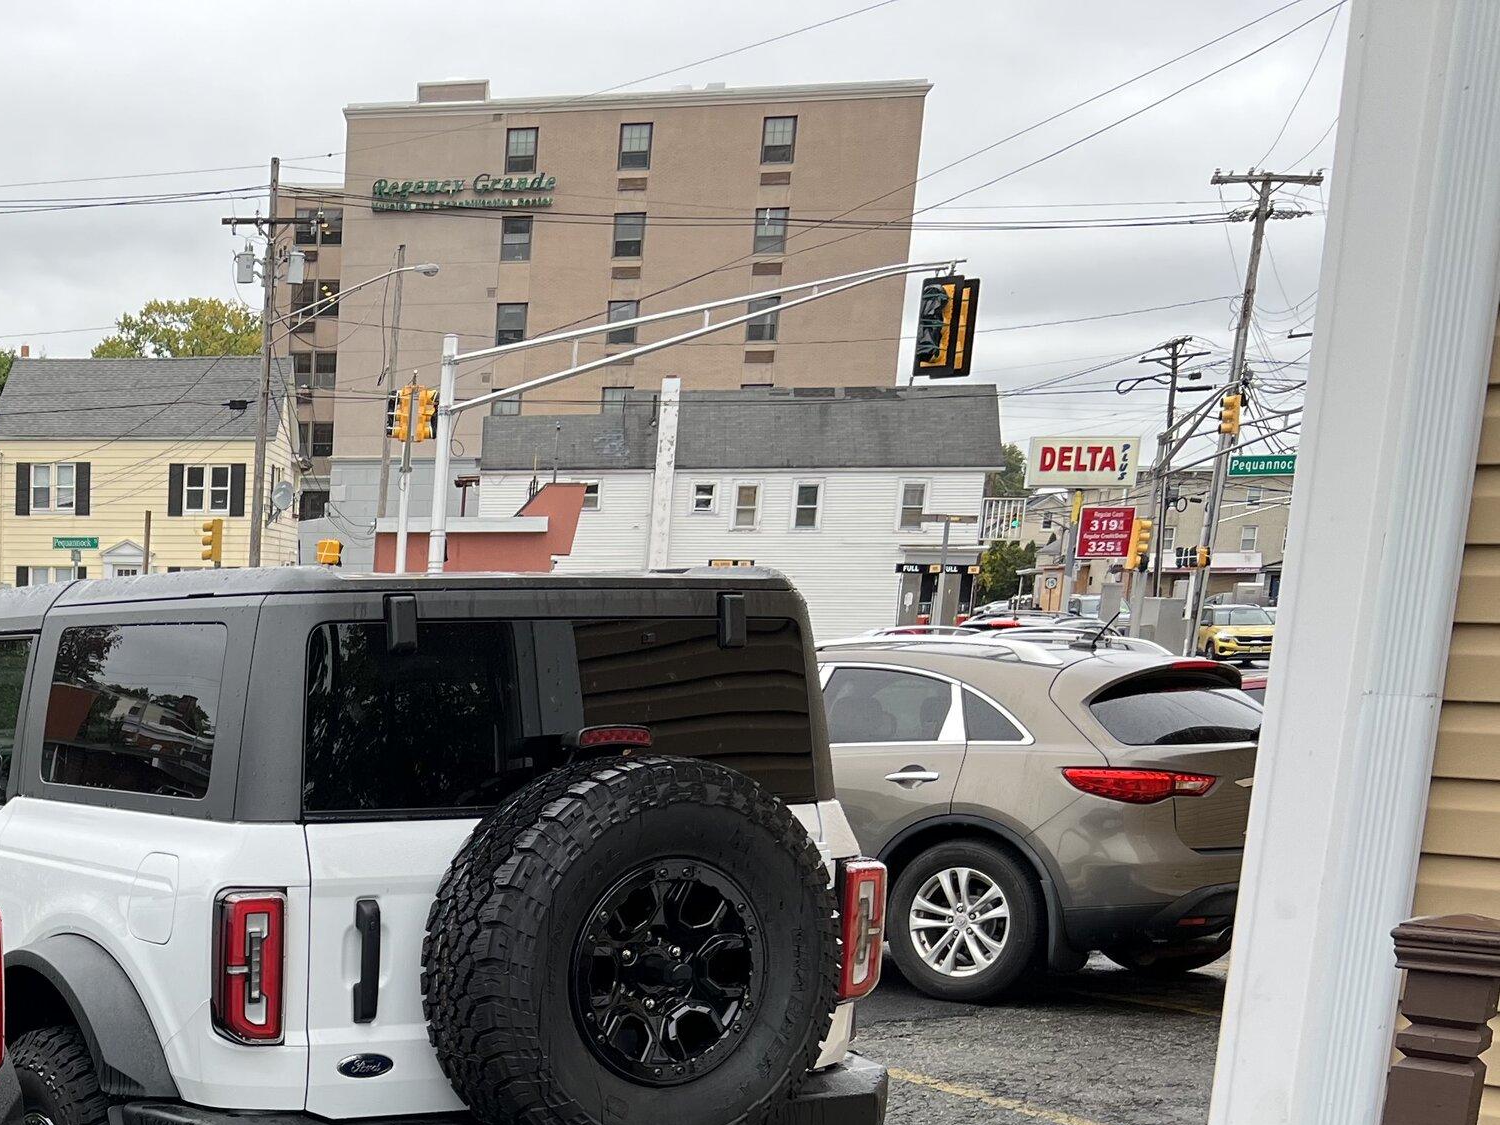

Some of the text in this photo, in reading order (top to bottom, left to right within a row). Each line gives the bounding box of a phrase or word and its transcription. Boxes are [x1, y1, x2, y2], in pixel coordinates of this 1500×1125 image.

[373, 172, 556, 198] Regency Grande
[1039, 446, 1116, 472] DELTA
[1117, 443, 1131, 481] PLUS
[1232, 459, 1296, 472] Pequannoc
[1090, 520, 1118, 530] 319
[1088, 541, 1115, 552] 325
[350, 1059, 382, 1074] Ford
